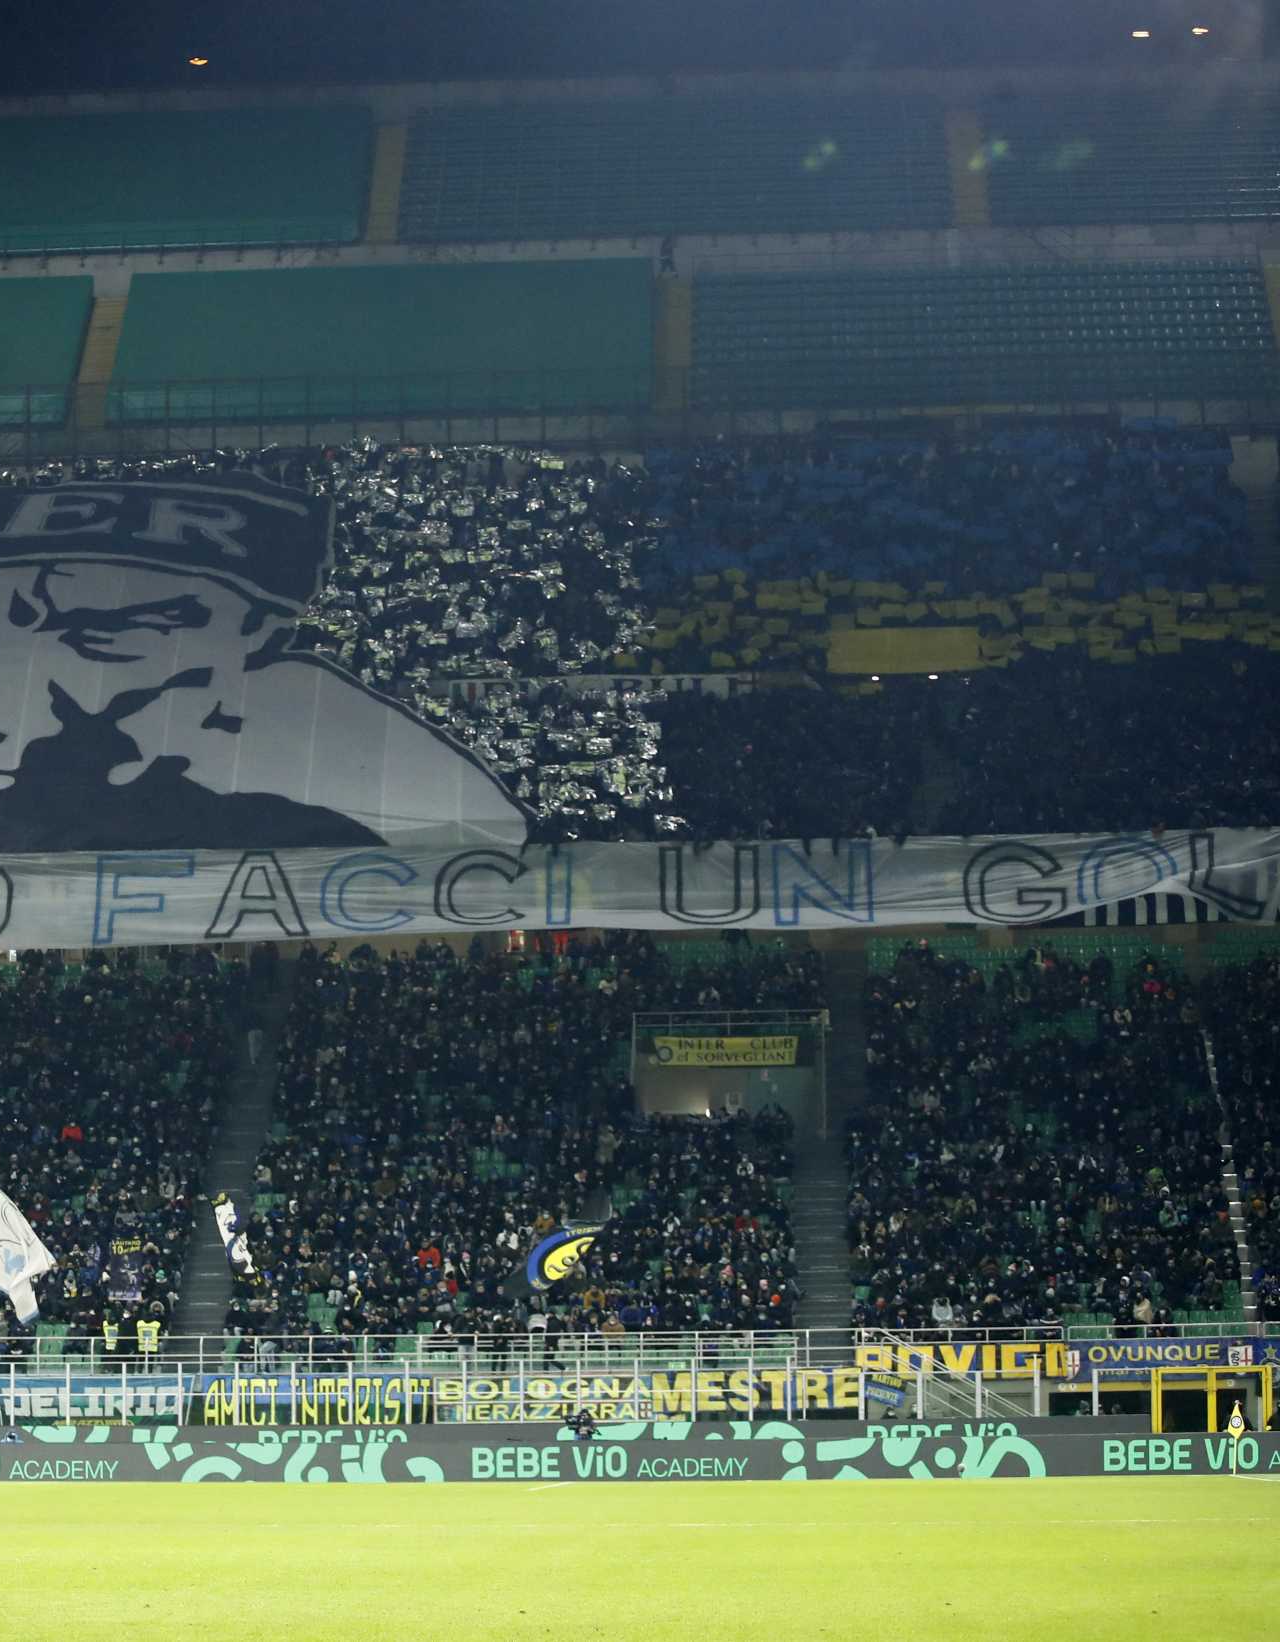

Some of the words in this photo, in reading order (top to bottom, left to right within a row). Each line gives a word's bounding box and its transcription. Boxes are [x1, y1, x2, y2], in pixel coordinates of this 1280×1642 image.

[91, 849, 573, 946] FACCI
[658, 841, 875, 926] UN
[963, 831, 1268, 926] GOL
[750, 1038, 794, 1050] CLUB
[1088, 1344, 1220, 1363] OVUNQUE
[1, 1386, 185, 1417] DELIRIO
[203, 1377, 279, 1425] AMICI
[438, 1377, 652, 1400] BOLOGNA
[651, 1367, 860, 1414] MESTRE
[9, 1460, 119, 1480] ACADEMY
[472, 1446, 561, 1479] BEBE
[637, 1457, 749, 1478] ACADEMY
[1103, 1439, 1192, 1472] BEBE
